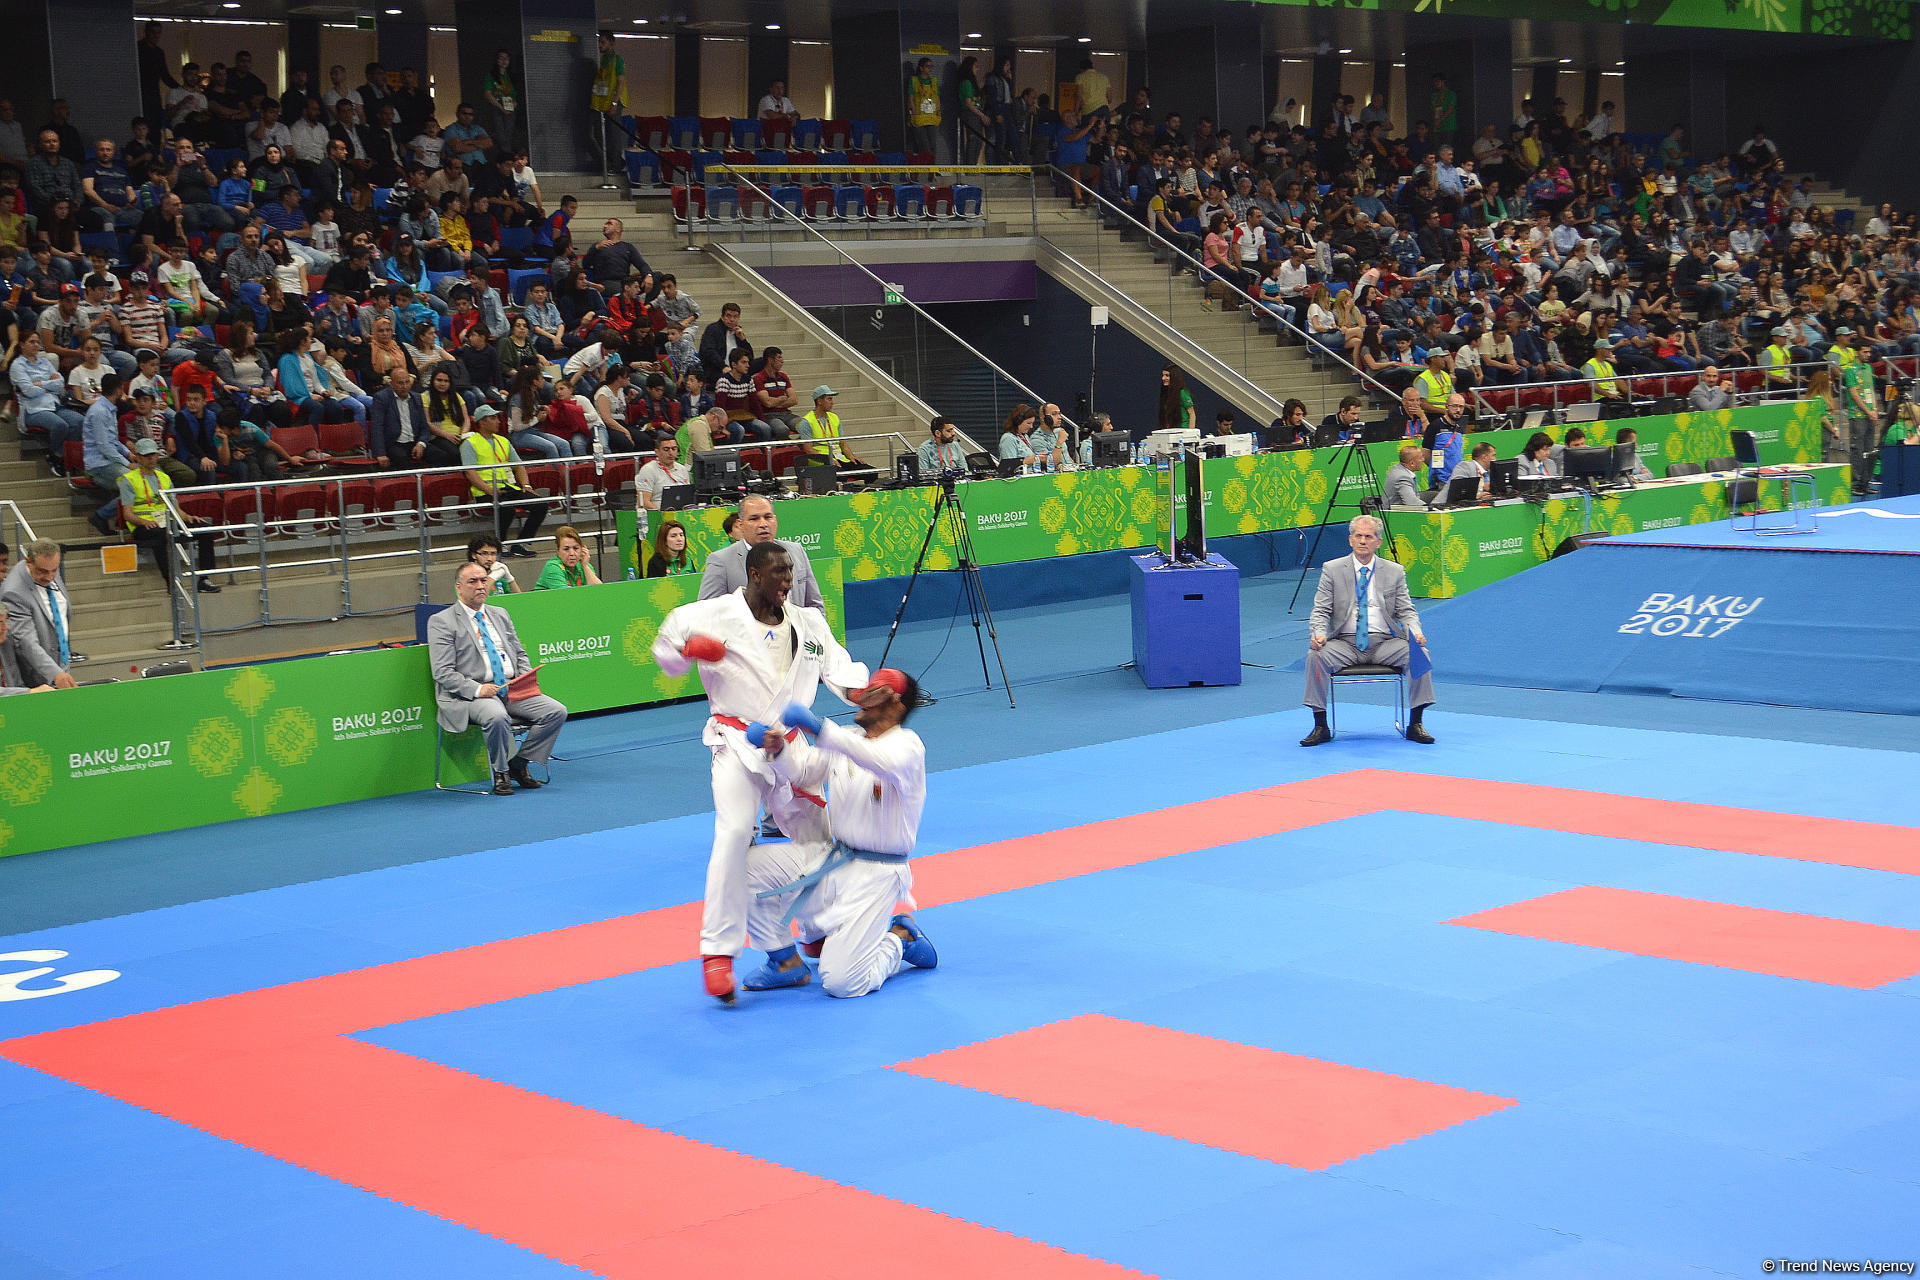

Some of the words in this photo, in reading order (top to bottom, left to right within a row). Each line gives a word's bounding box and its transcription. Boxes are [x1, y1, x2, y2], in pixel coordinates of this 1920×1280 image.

[977, 513, 1002, 525] BAKU
[1004, 510, 1028, 522] 2017
[794, 533, 821, 545] 2017
[1479, 540, 1501, 552] BAKU
[1502, 536, 1523, 549] 2017
[1637, 592, 1765, 617] BAKU
[1617, 613, 1745, 639] 2017
[539, 639, 574, 656] BAKU
[577, 634, 611, 651] 2017
[332, 712, 377, 732] BAKU
[381, 706, 422, 725] 2017
[69, 748, 119, 769] BAKU
[124, 740, 170, 761] 2017
[110, 762, 146, 773] Solidarity
[147, 759, 173, 768] Games
